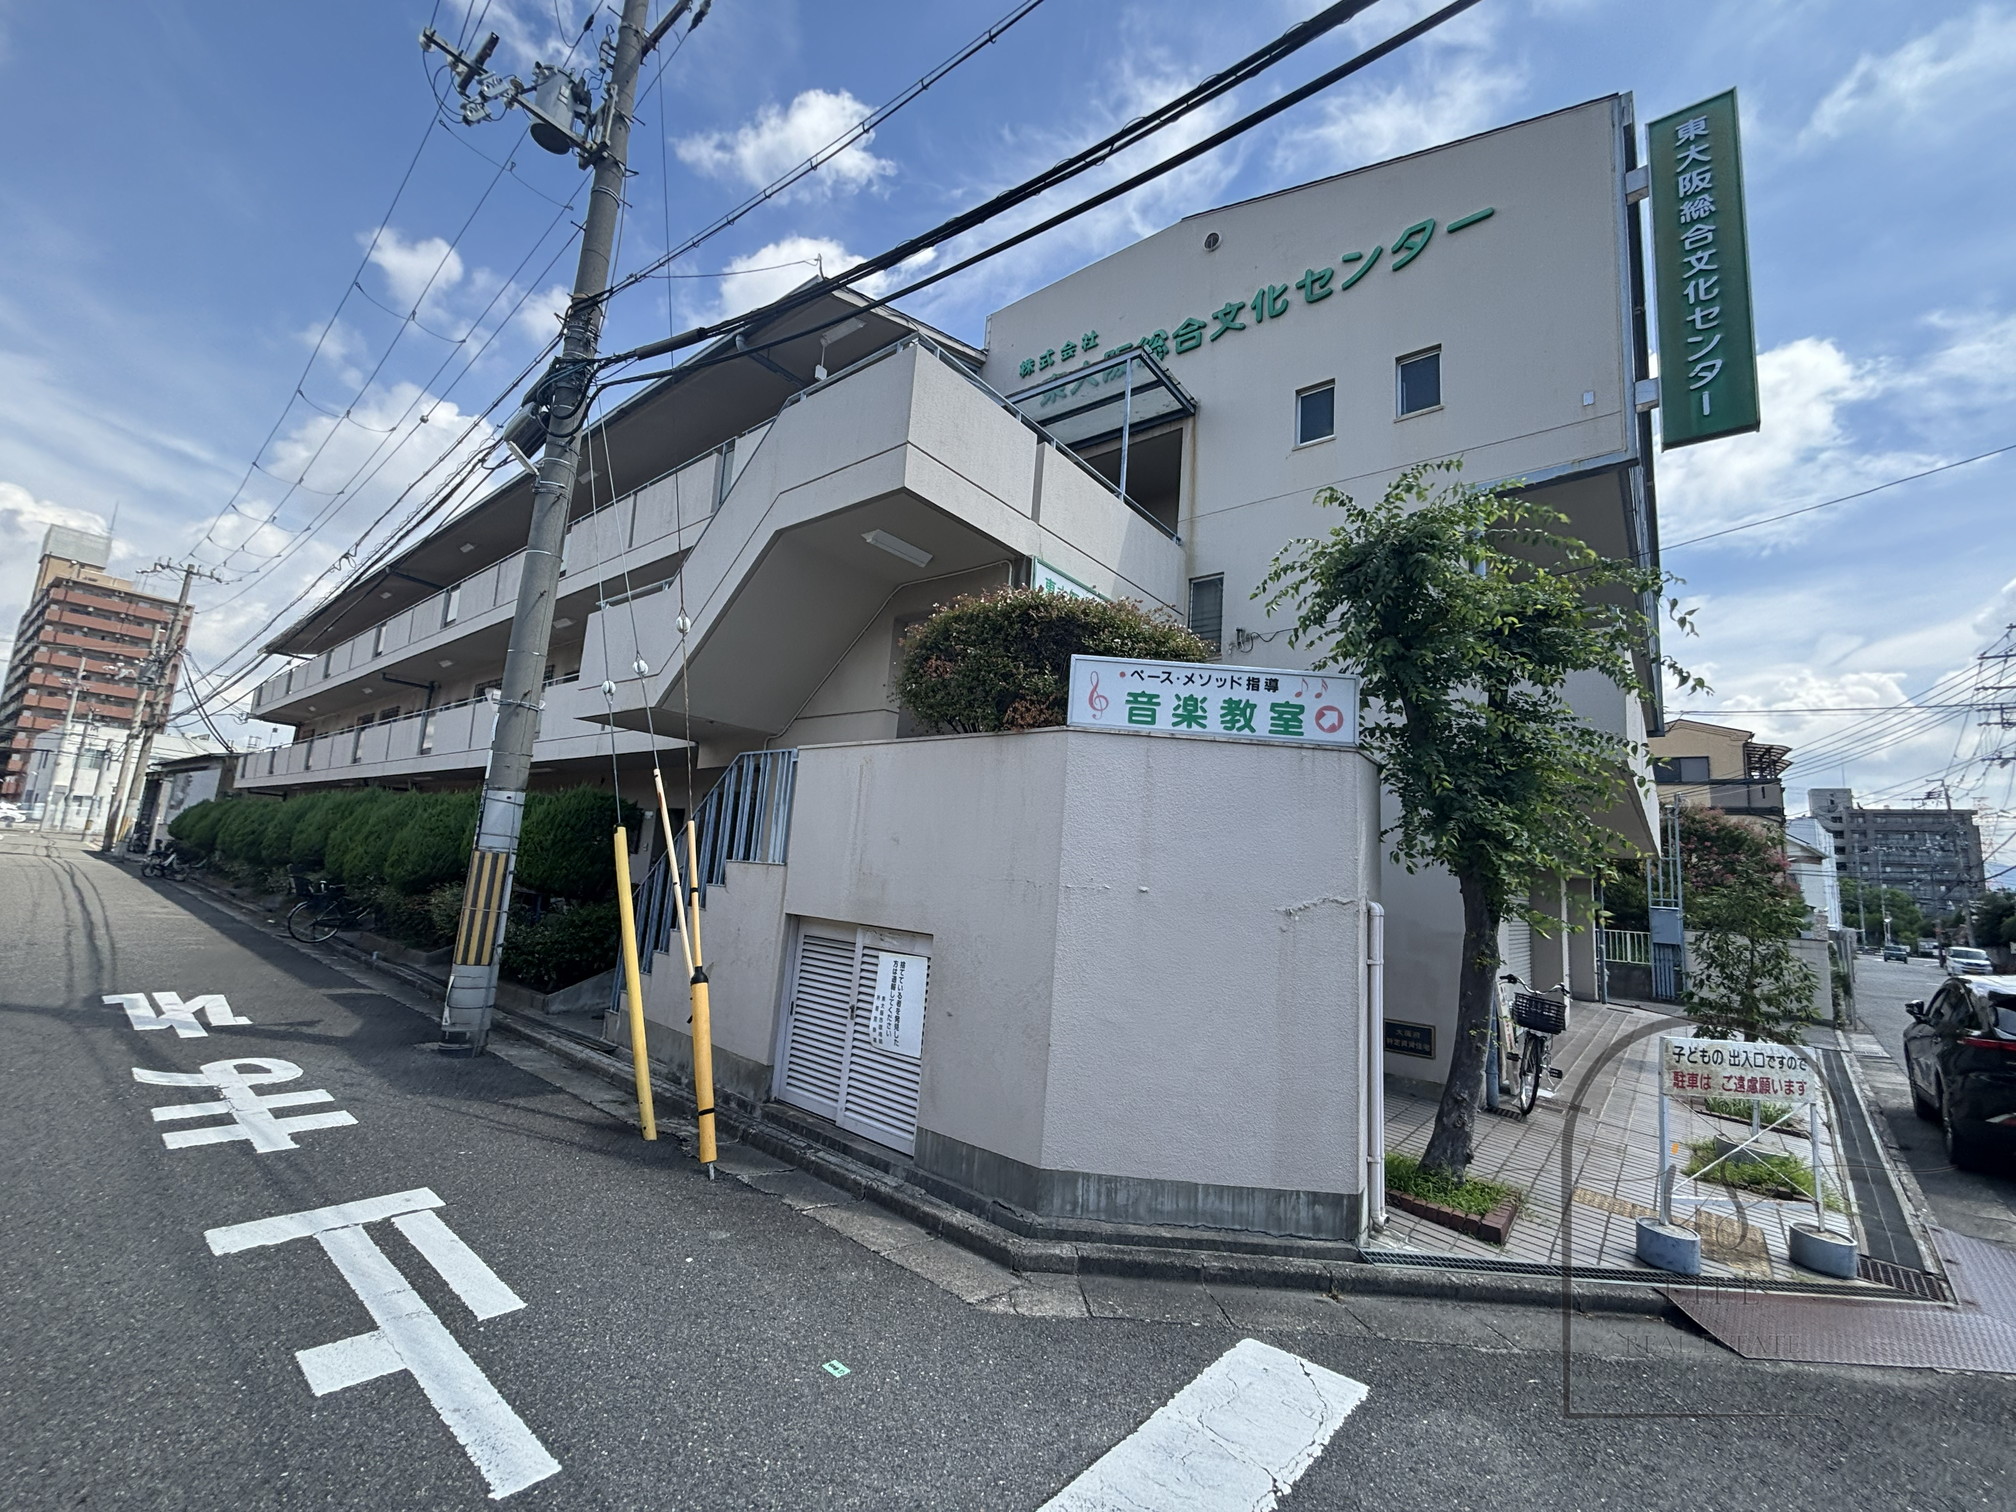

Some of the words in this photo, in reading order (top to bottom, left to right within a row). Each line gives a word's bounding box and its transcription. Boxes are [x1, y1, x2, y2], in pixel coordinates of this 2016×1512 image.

[1675, 114, 1723, 416] 東大阪総合文化センター
[1018, 329, 1100, 380] 株式会社
[1124, 689, 1306, 737] 音楽教室
[1672, 1070, 1712, 1090] 駐車は
[1721, 1074, 1808, 1097] ご遠慮願います
[101, 991, 562, 1500] 止まれ
